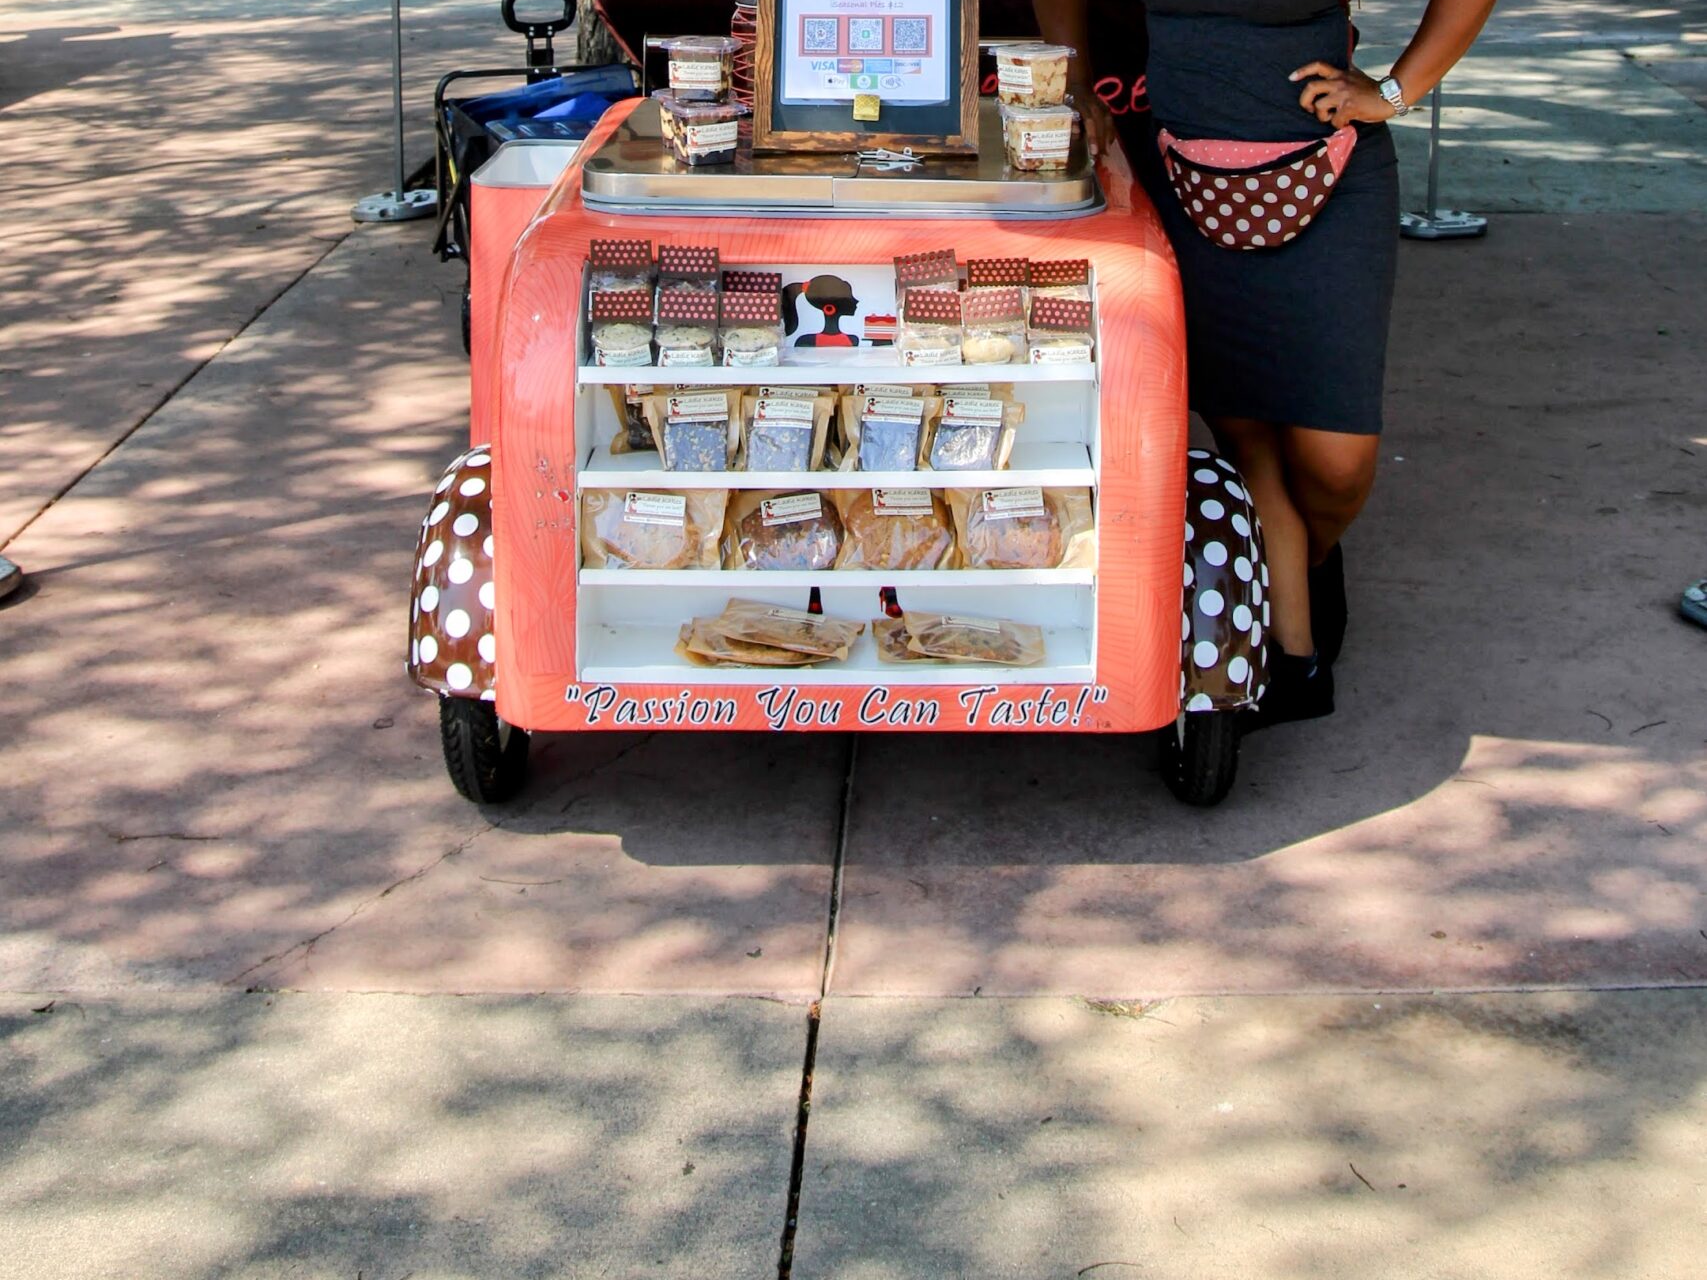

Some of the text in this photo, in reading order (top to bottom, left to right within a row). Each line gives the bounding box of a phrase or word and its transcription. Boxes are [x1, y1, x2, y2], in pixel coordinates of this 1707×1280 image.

[831, 0, 868, 9] Seasonal
[810, 61, 836, 71] VISA
[565, 685, 1109, 731] "Passion You Can Taste!"
